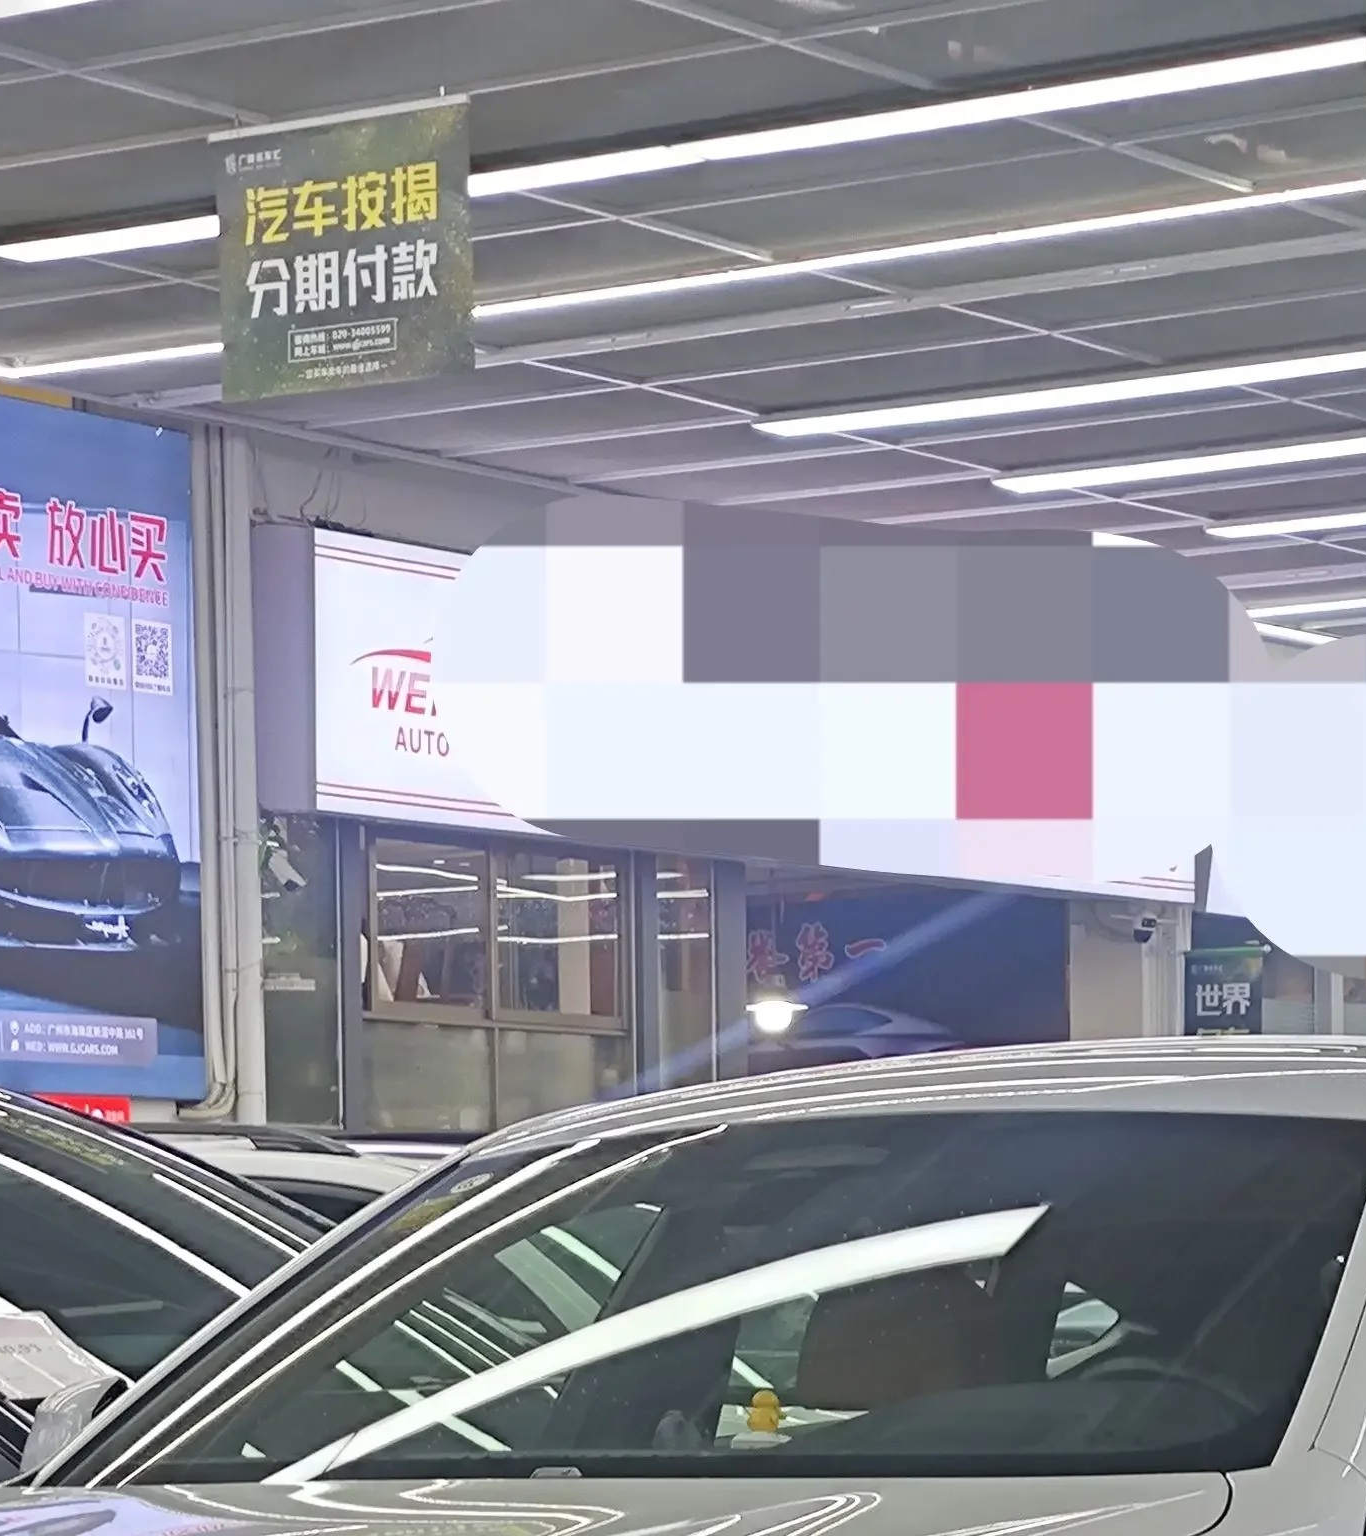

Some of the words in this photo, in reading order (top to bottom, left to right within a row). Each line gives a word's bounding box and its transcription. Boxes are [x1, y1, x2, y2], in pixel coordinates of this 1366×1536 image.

[245, 161, 437, 246] 汽车按揭
[246, 239, 437, 319] 分期付款
[46, 496, 168, 583] 放心买
[7, 567, 32, 585] AND
[35, 572, 60, 589] BUY
[60, 575, 94, 595] WITH
[371, 666, 437, 716] WE
[395, 726, 450, 757] AUTO
[1195, 983, 1251, 1016] 世界
